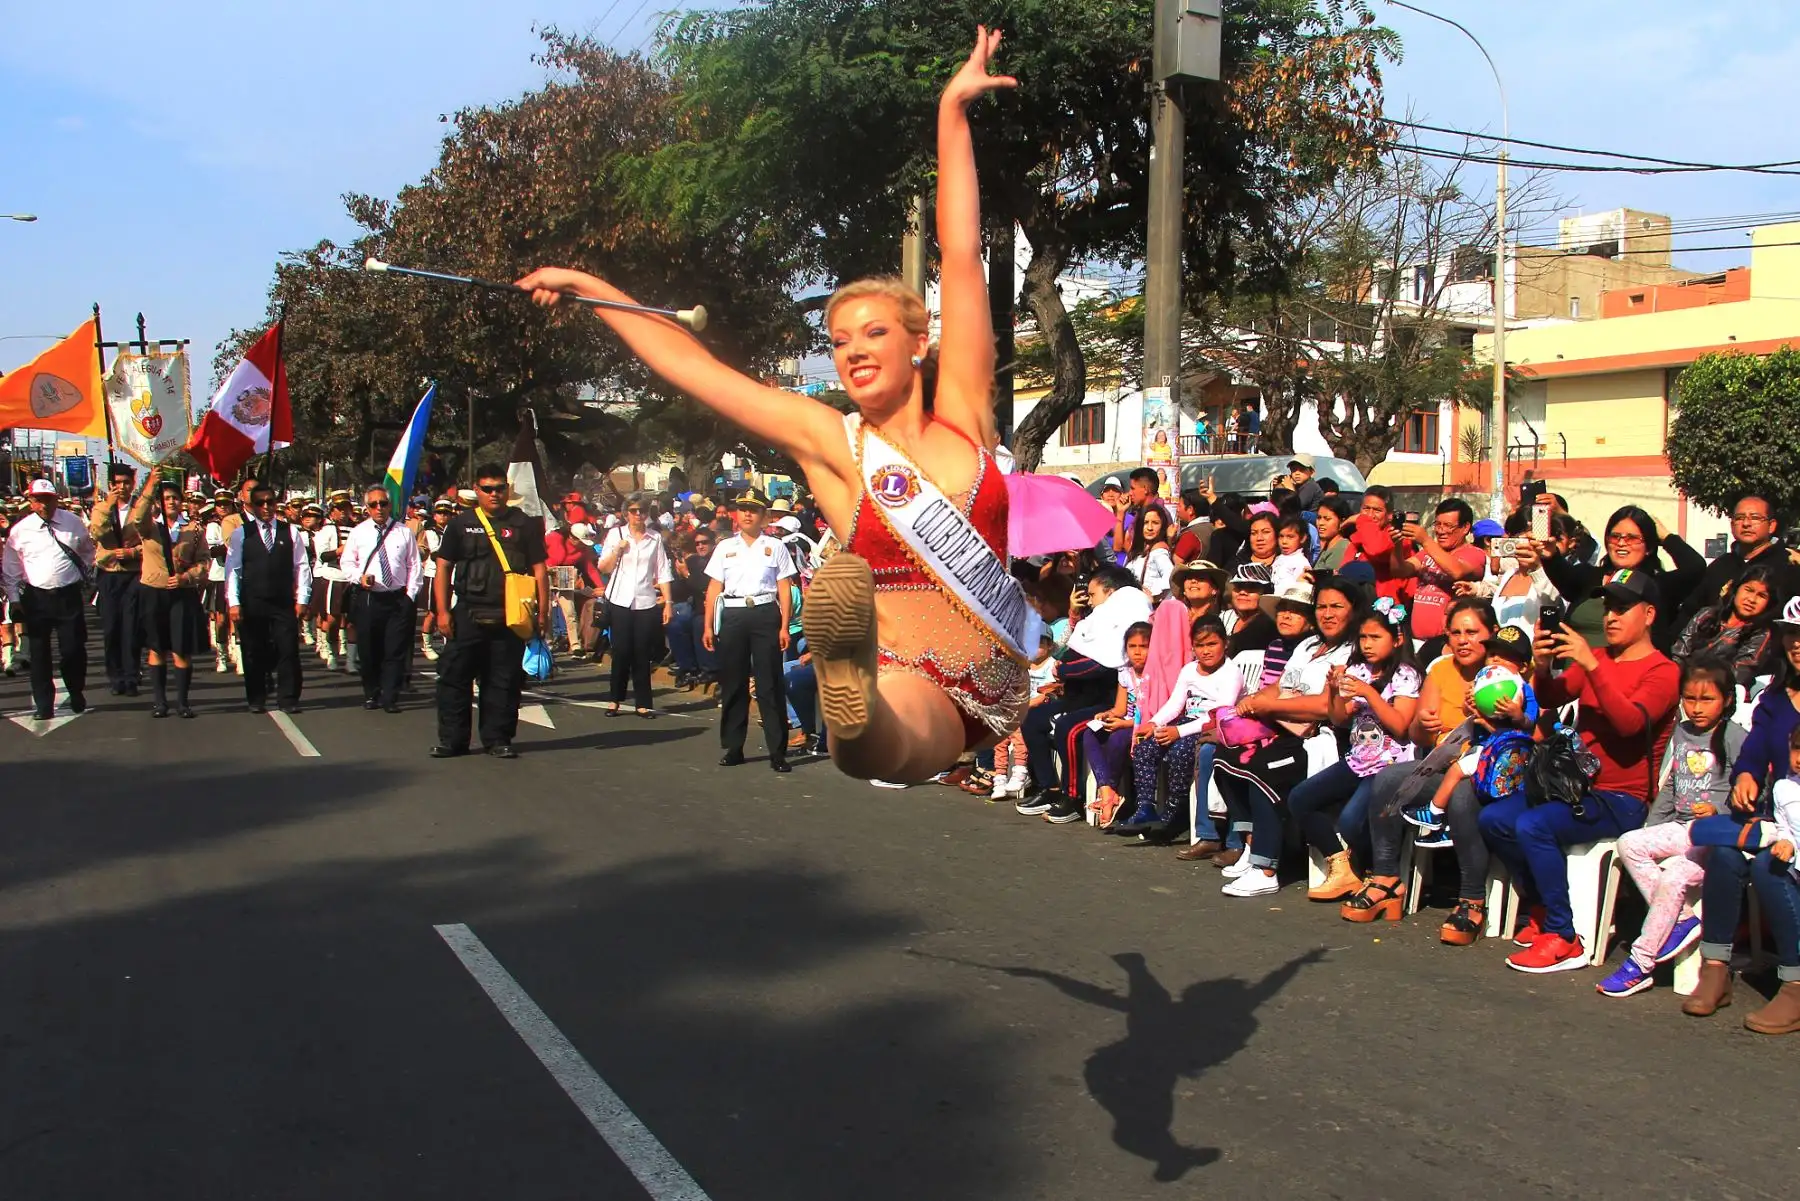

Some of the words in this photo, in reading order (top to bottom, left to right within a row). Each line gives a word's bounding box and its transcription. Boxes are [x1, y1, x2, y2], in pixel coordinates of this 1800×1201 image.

[883, 475, 900, 496] L
[912, 499, 963, 552] CLUB
[938, 528, 980, 571] DE
[953, 544, 1010, 610] LEONES
